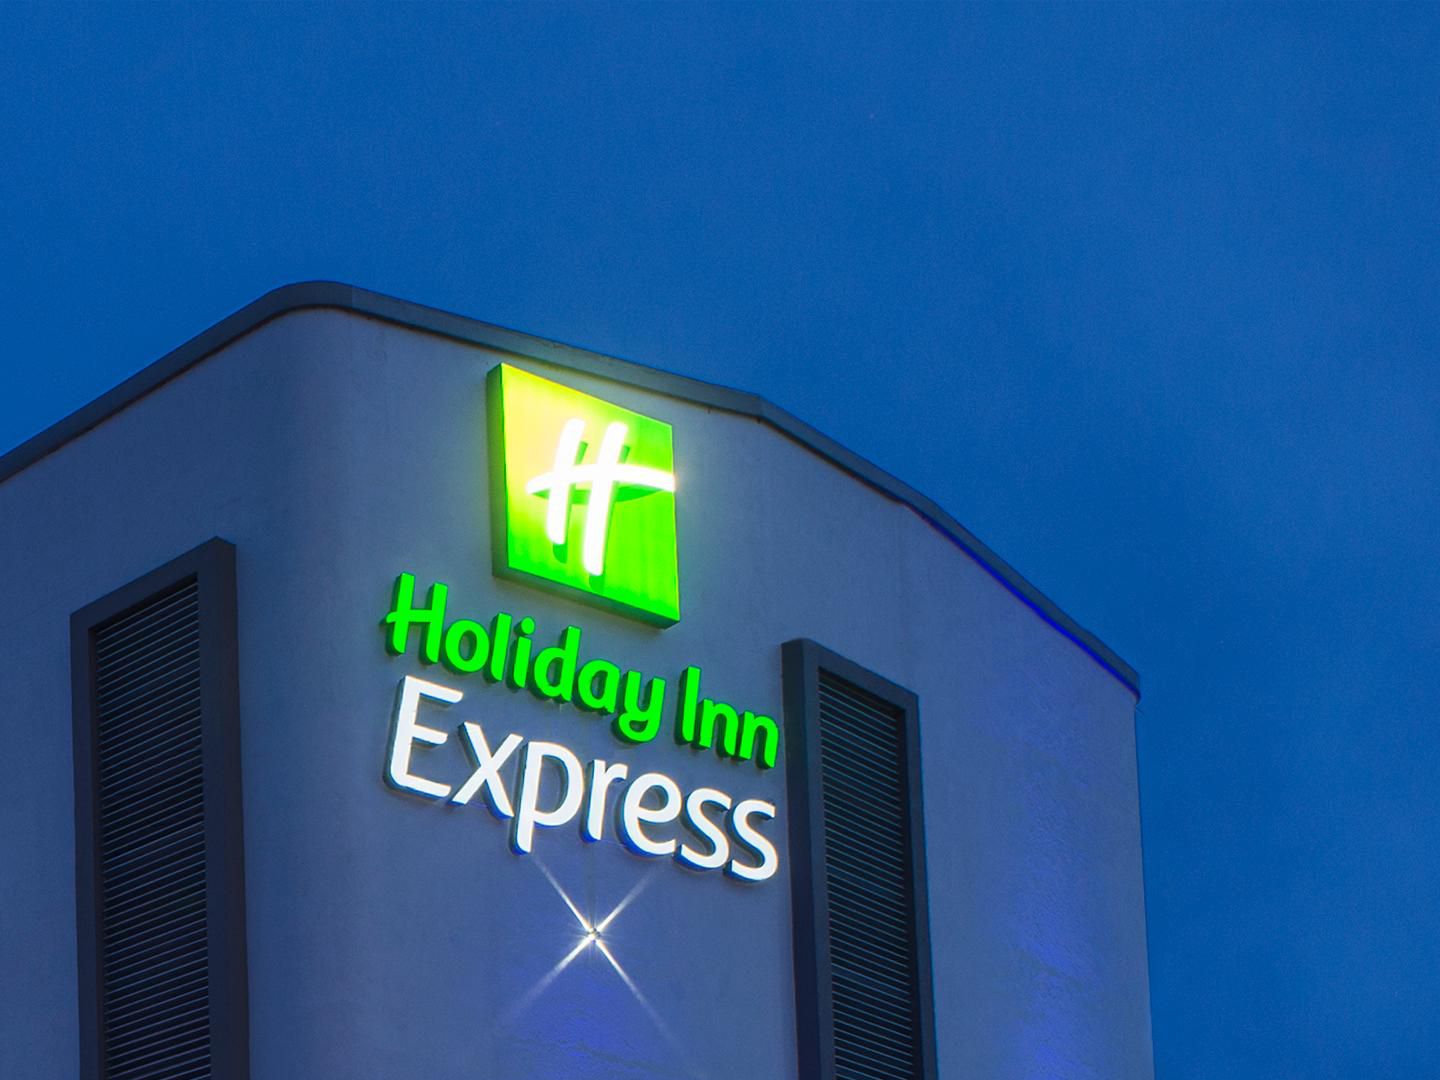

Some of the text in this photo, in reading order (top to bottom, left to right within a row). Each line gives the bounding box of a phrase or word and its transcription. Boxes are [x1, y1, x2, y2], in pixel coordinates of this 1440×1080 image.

[384, 572, 779, 768] Holiday Inn
[386, 675, 779, 882] Express
